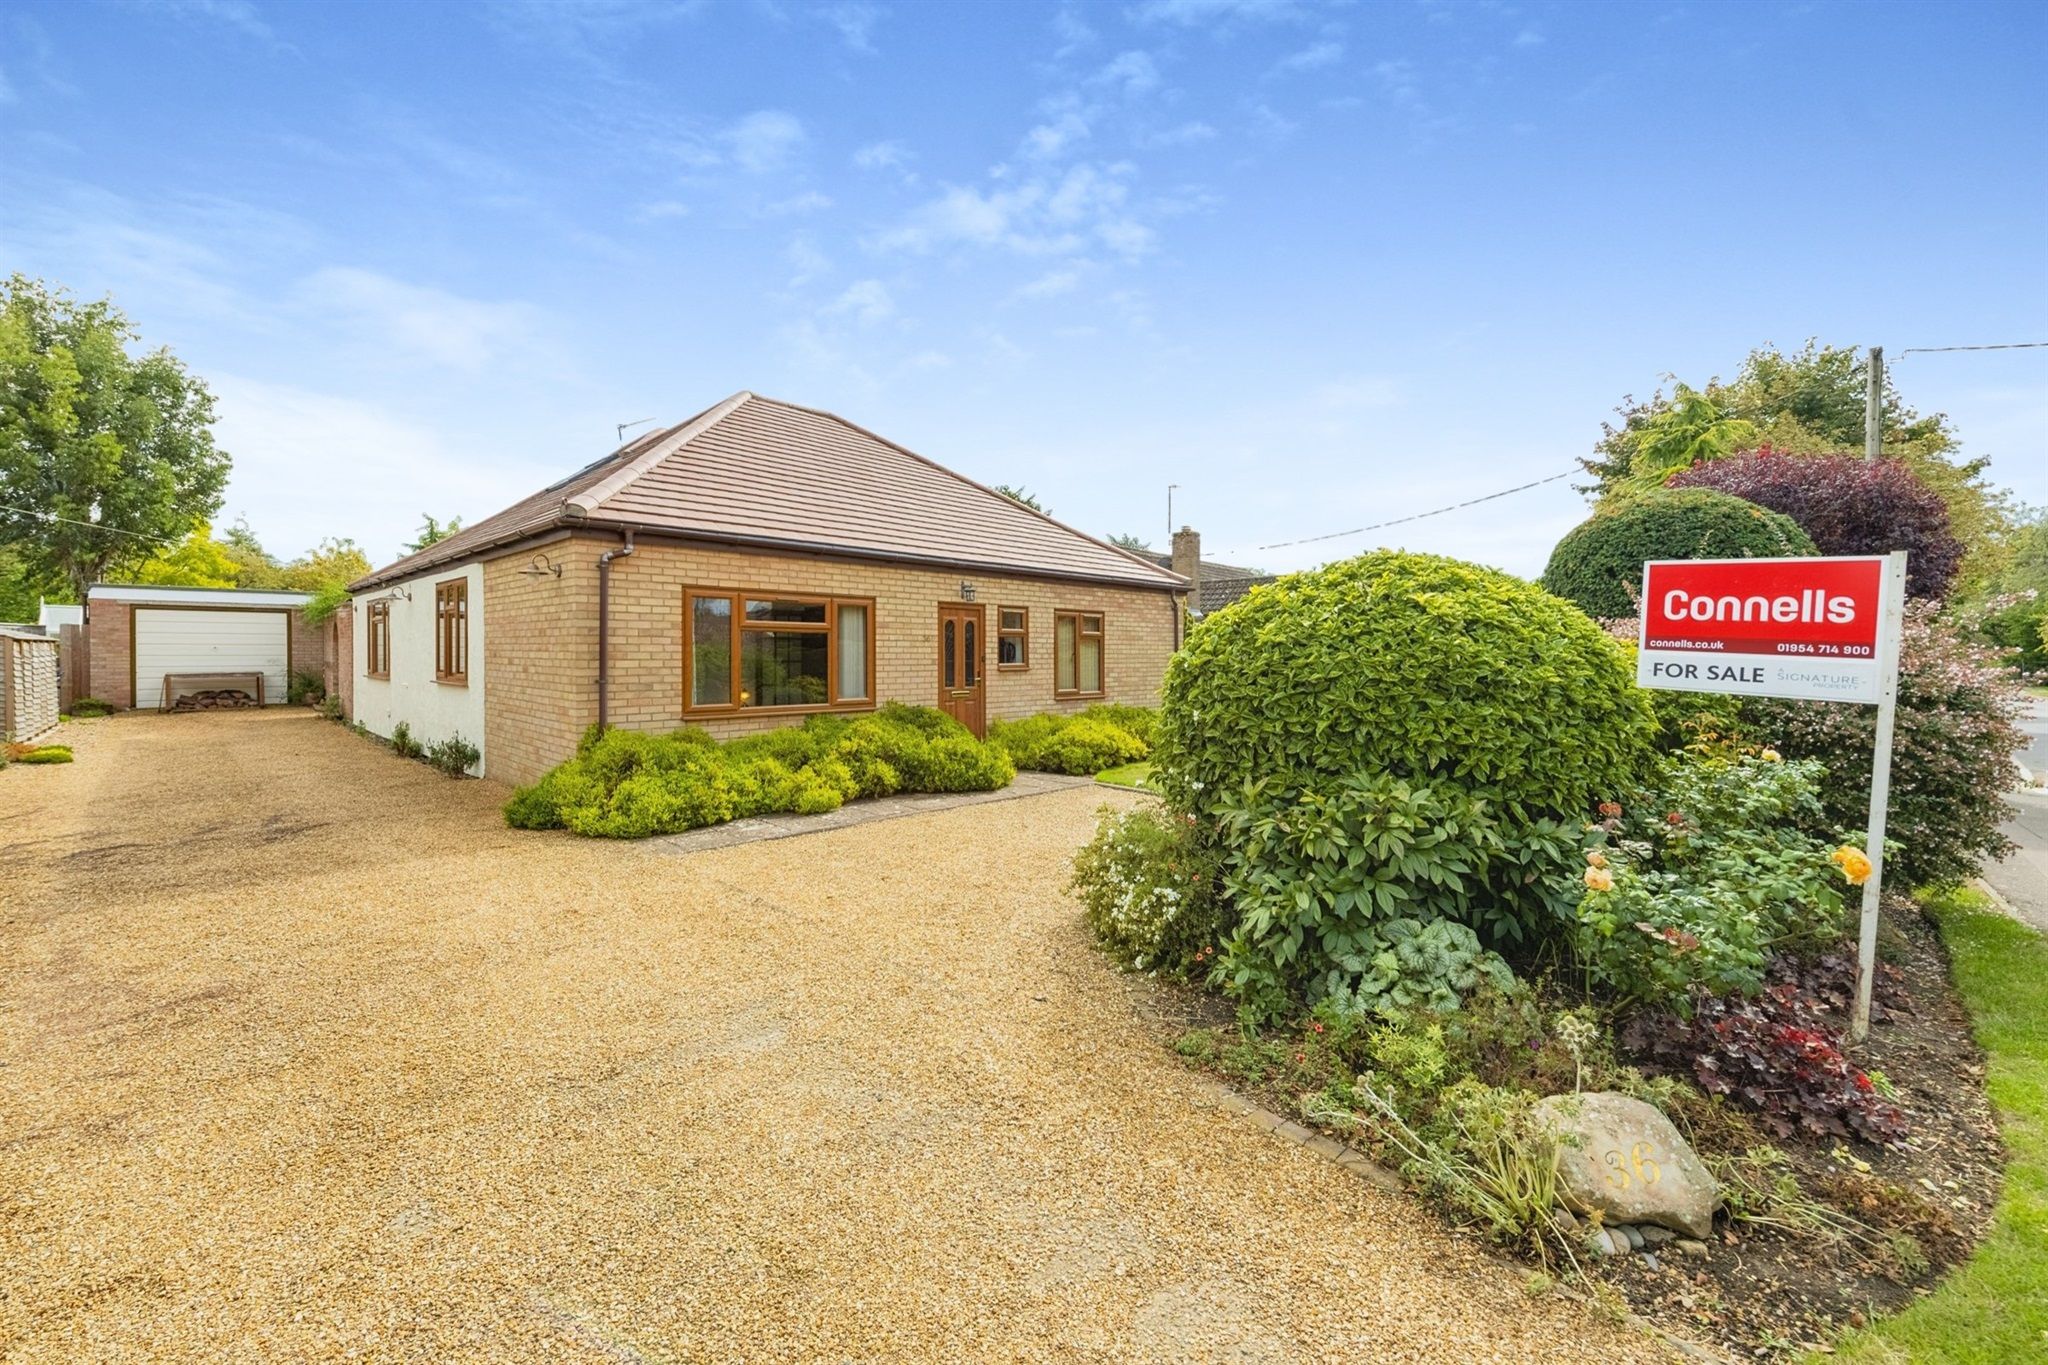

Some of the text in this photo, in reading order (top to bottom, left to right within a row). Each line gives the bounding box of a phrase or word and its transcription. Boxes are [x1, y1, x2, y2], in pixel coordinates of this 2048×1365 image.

[1664, 589, 1855, 624] Connells
[1650, 639, 1724, 650] connells.co.uk
[1777, 643, 1870, 655] 01954 714 900
[1653, 662, 1765, 683] FOR SALE
[1777, 672, 1859, 685] SIGNATURE
[1605, 1141, 1661, 1189] 36
